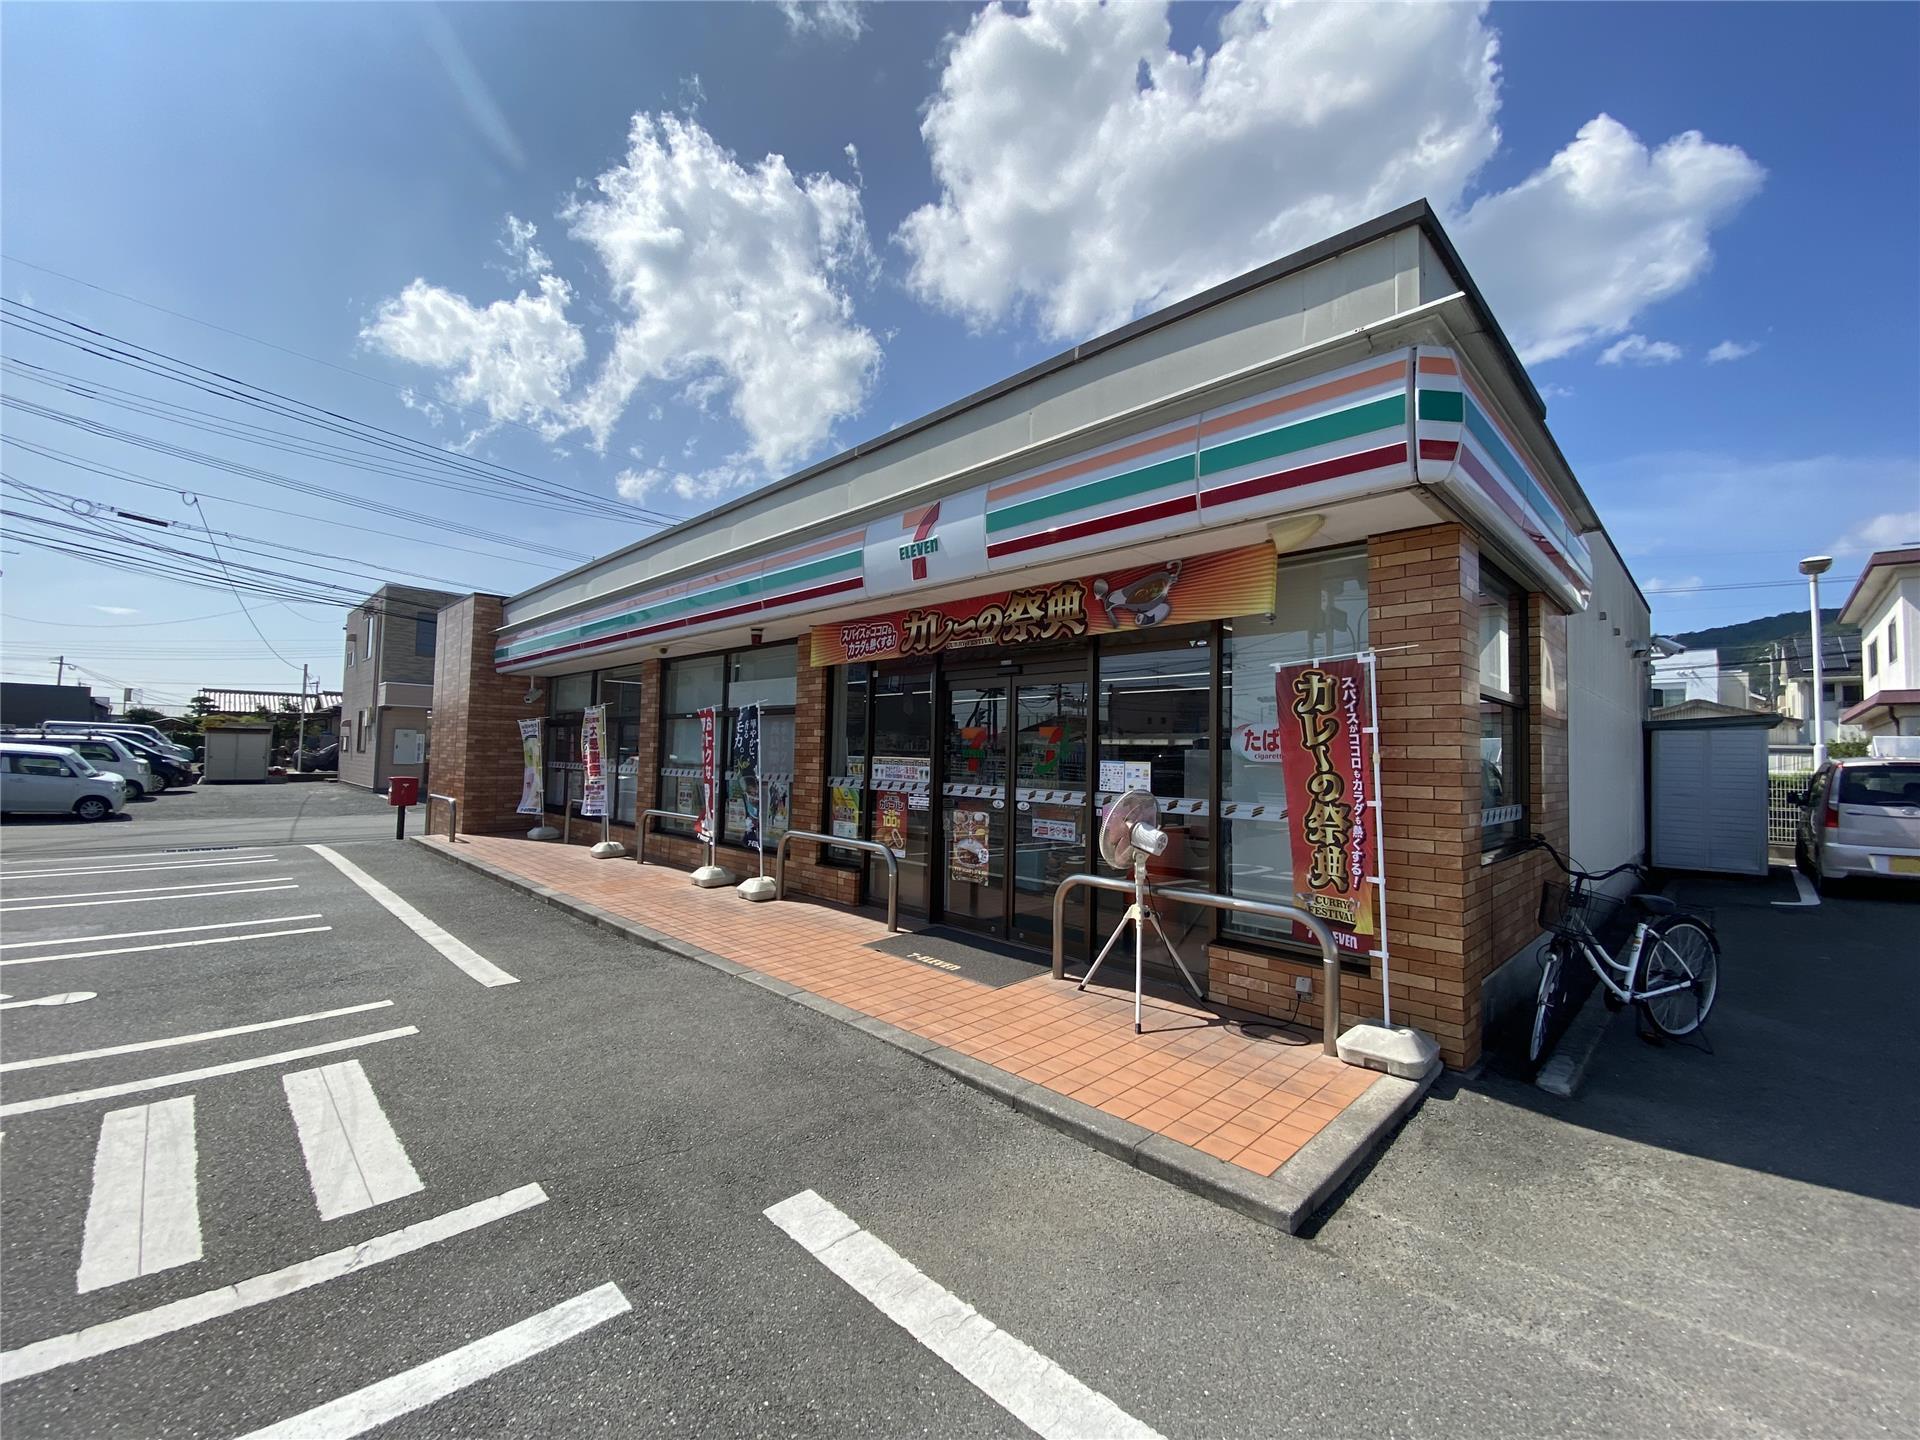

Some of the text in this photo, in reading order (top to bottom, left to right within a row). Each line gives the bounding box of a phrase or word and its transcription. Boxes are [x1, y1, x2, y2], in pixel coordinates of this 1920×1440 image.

[900, 584, 1086, 652] カレーの祭典
[1244, 729, 1281, 752] たば
[1254, 752, 1283, 760] cigarett
[1294, 671, 1352, 892] カレーの祭典
[1315, 895, 1350, 910] CURRY
[1308, 905, 1355, 922] FESTIVAL
